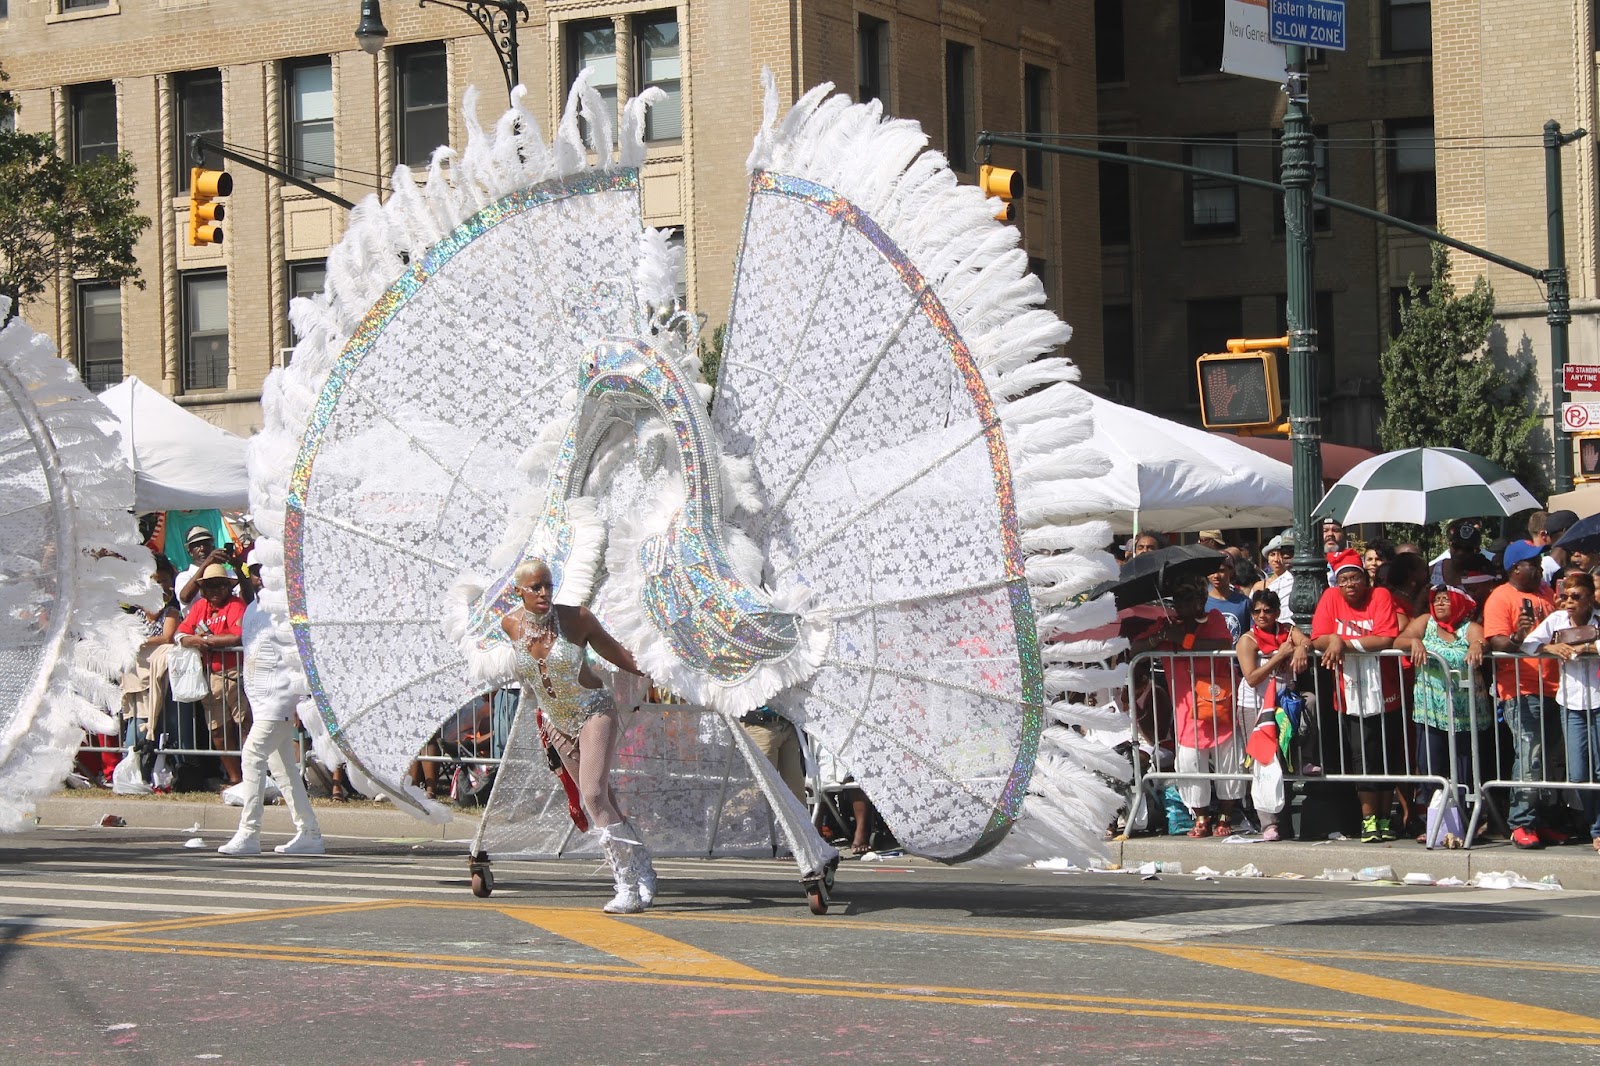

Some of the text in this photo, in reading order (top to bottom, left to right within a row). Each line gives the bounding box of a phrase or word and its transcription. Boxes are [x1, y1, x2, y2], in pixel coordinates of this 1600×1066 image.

[1273, 0, 1342, 27] Eastern Parkway
[1229, 20, 1245, 38] New
[1275, 21, 1341, 44] SLOW ZONE
[1566, 366, 1574, 374] NO
[1570, 374, 1598, 382] ANYTIME
